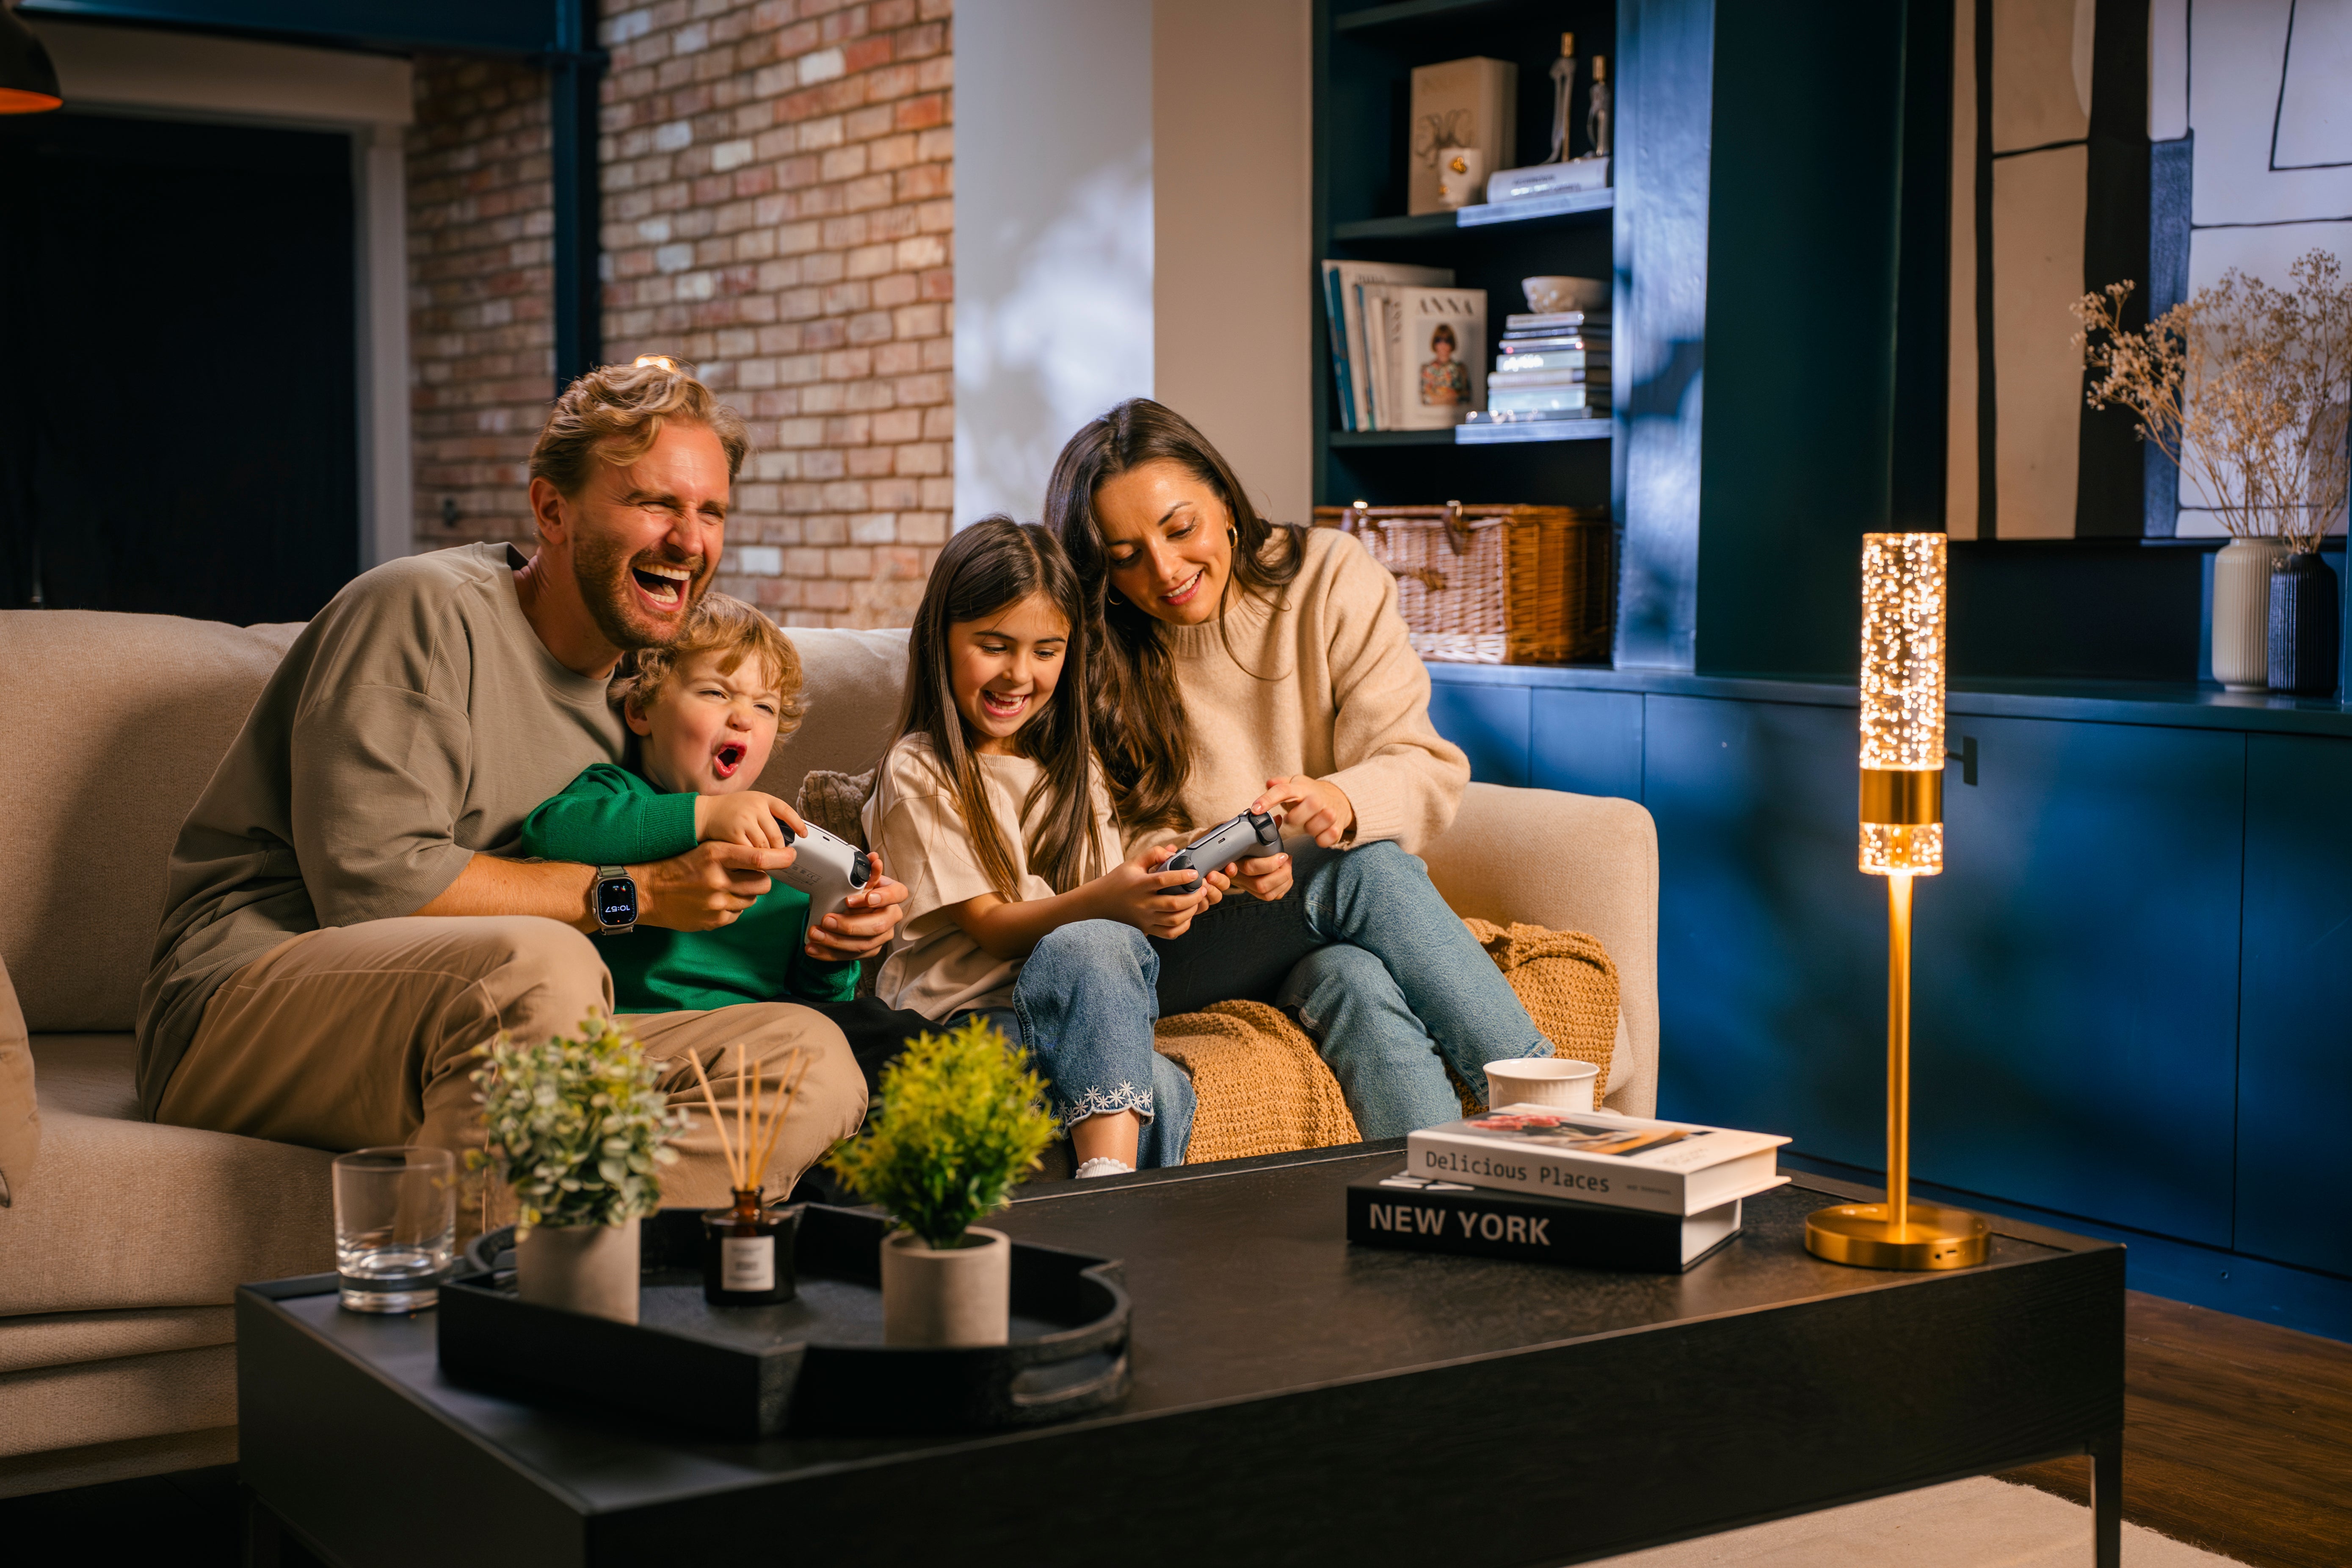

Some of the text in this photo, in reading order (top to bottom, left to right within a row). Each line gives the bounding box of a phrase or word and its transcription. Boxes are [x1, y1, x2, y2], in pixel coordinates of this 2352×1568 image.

[1426, 1151, 1527, 1181] Delicious
[1540, 1166, 1609, 1193] Places
[1369, 1203, 1551, 1246] NEW YORK
